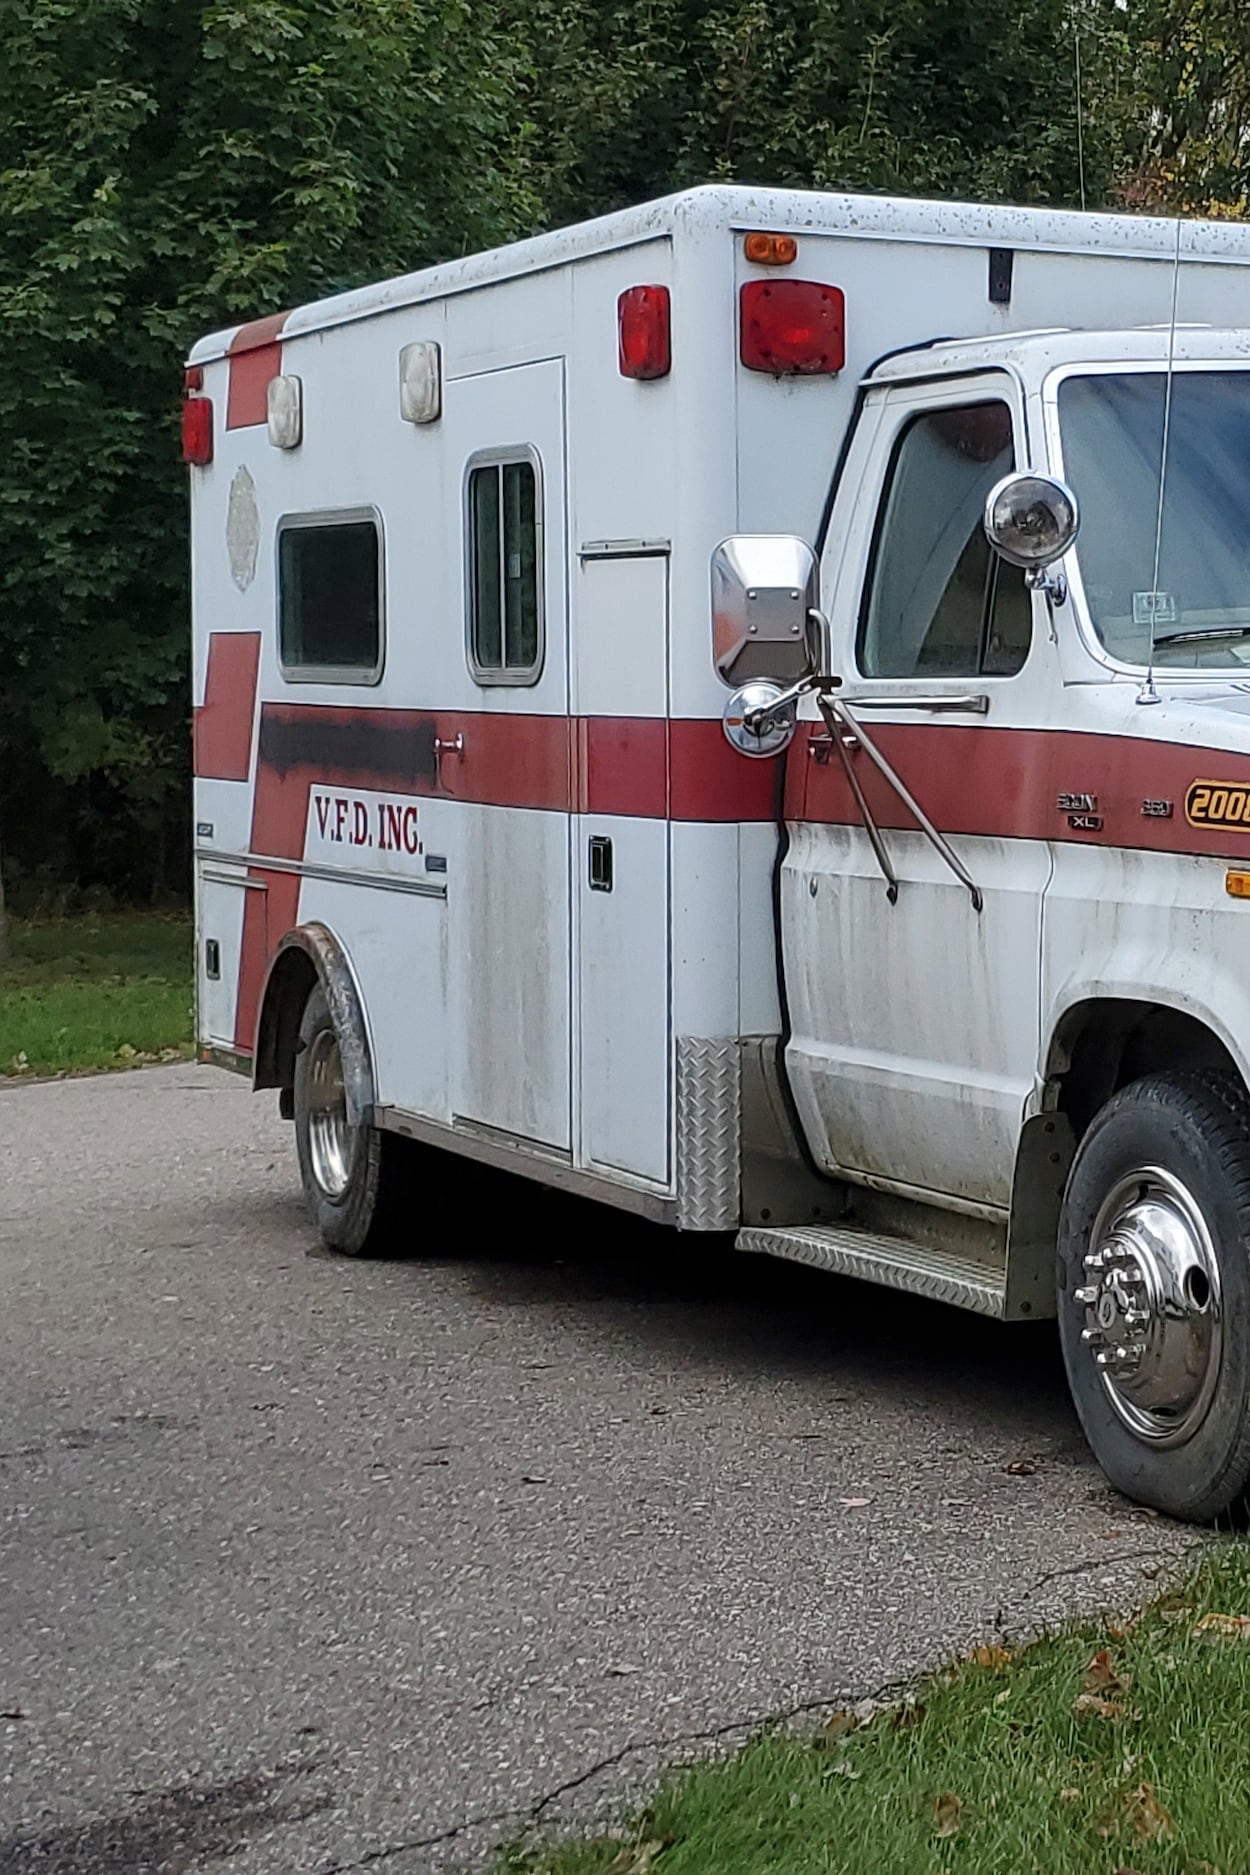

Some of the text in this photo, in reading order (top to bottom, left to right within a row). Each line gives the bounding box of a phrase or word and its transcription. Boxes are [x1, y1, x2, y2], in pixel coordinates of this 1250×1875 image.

[314, 795, 423, 855] V.F.D. INC.
[1072, 815, 1096, 828] XL
